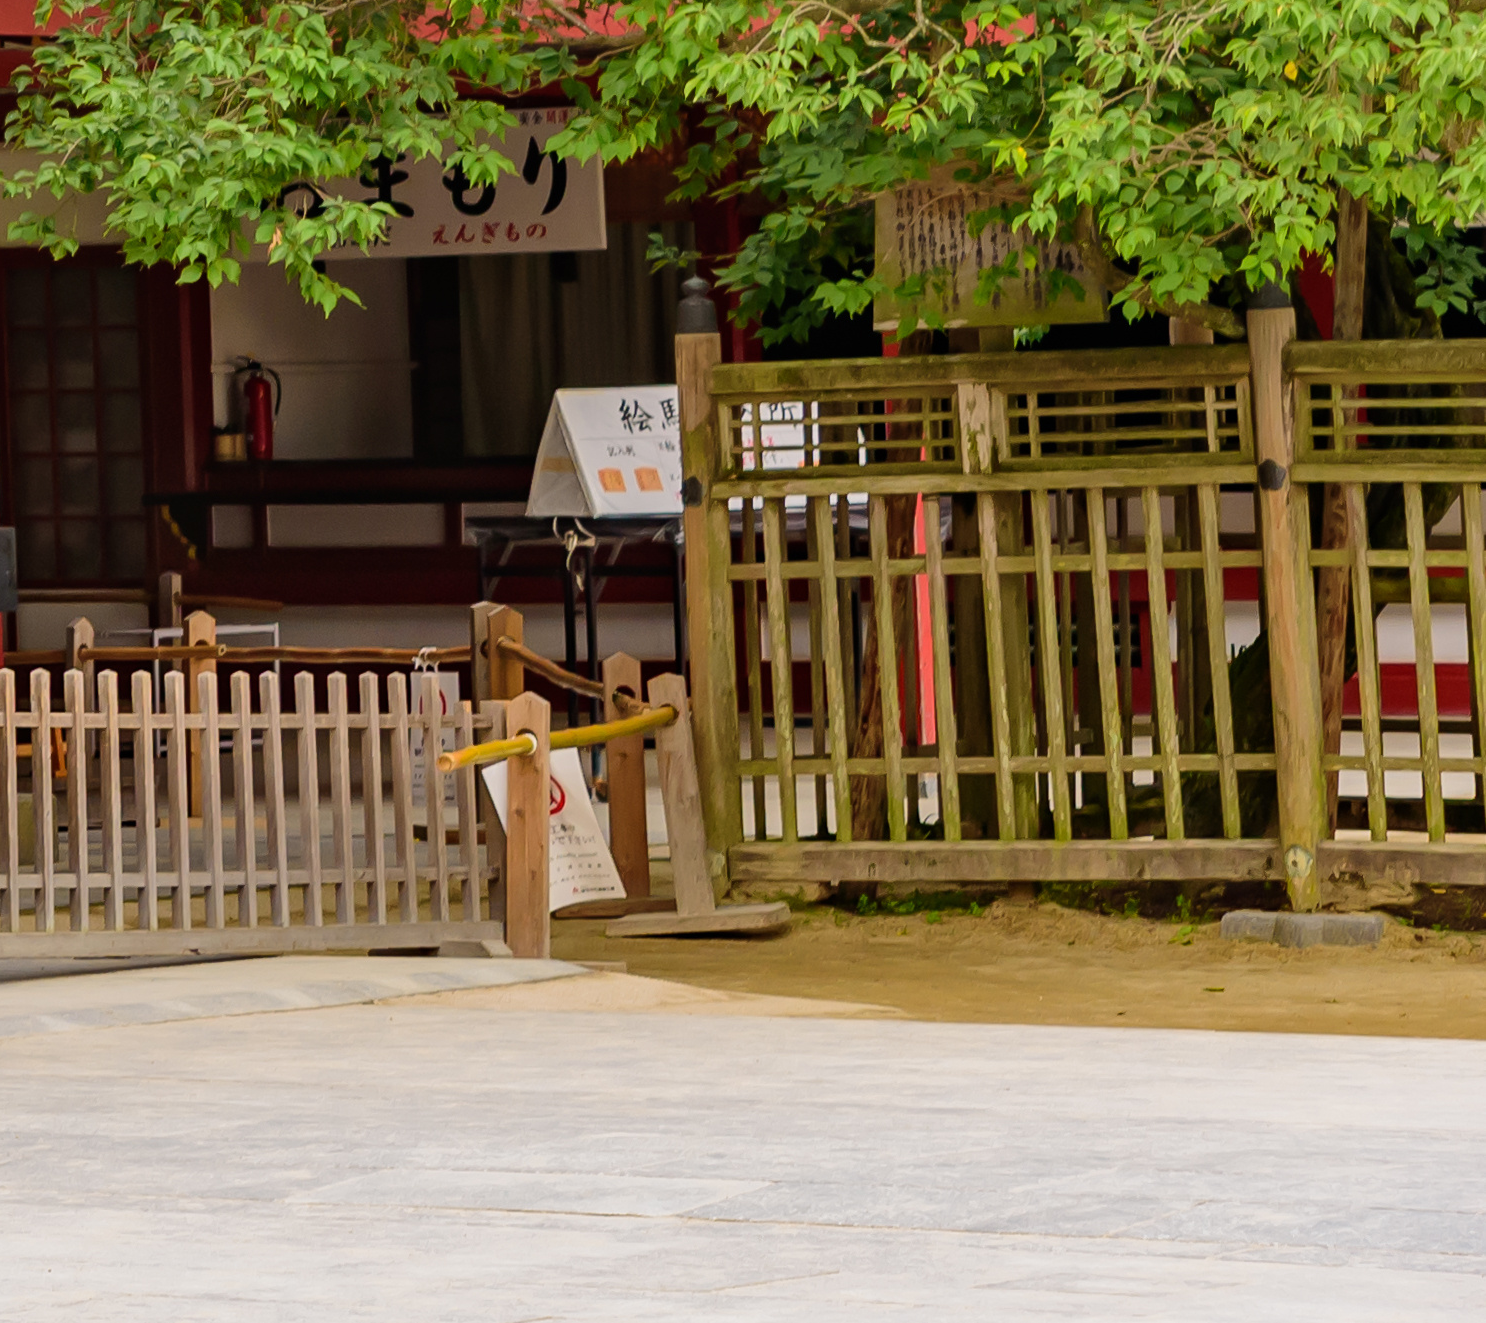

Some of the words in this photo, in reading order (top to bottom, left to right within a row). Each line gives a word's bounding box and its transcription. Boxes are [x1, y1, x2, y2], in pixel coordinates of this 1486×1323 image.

[433, 222, 547, 245] えんぎもの
